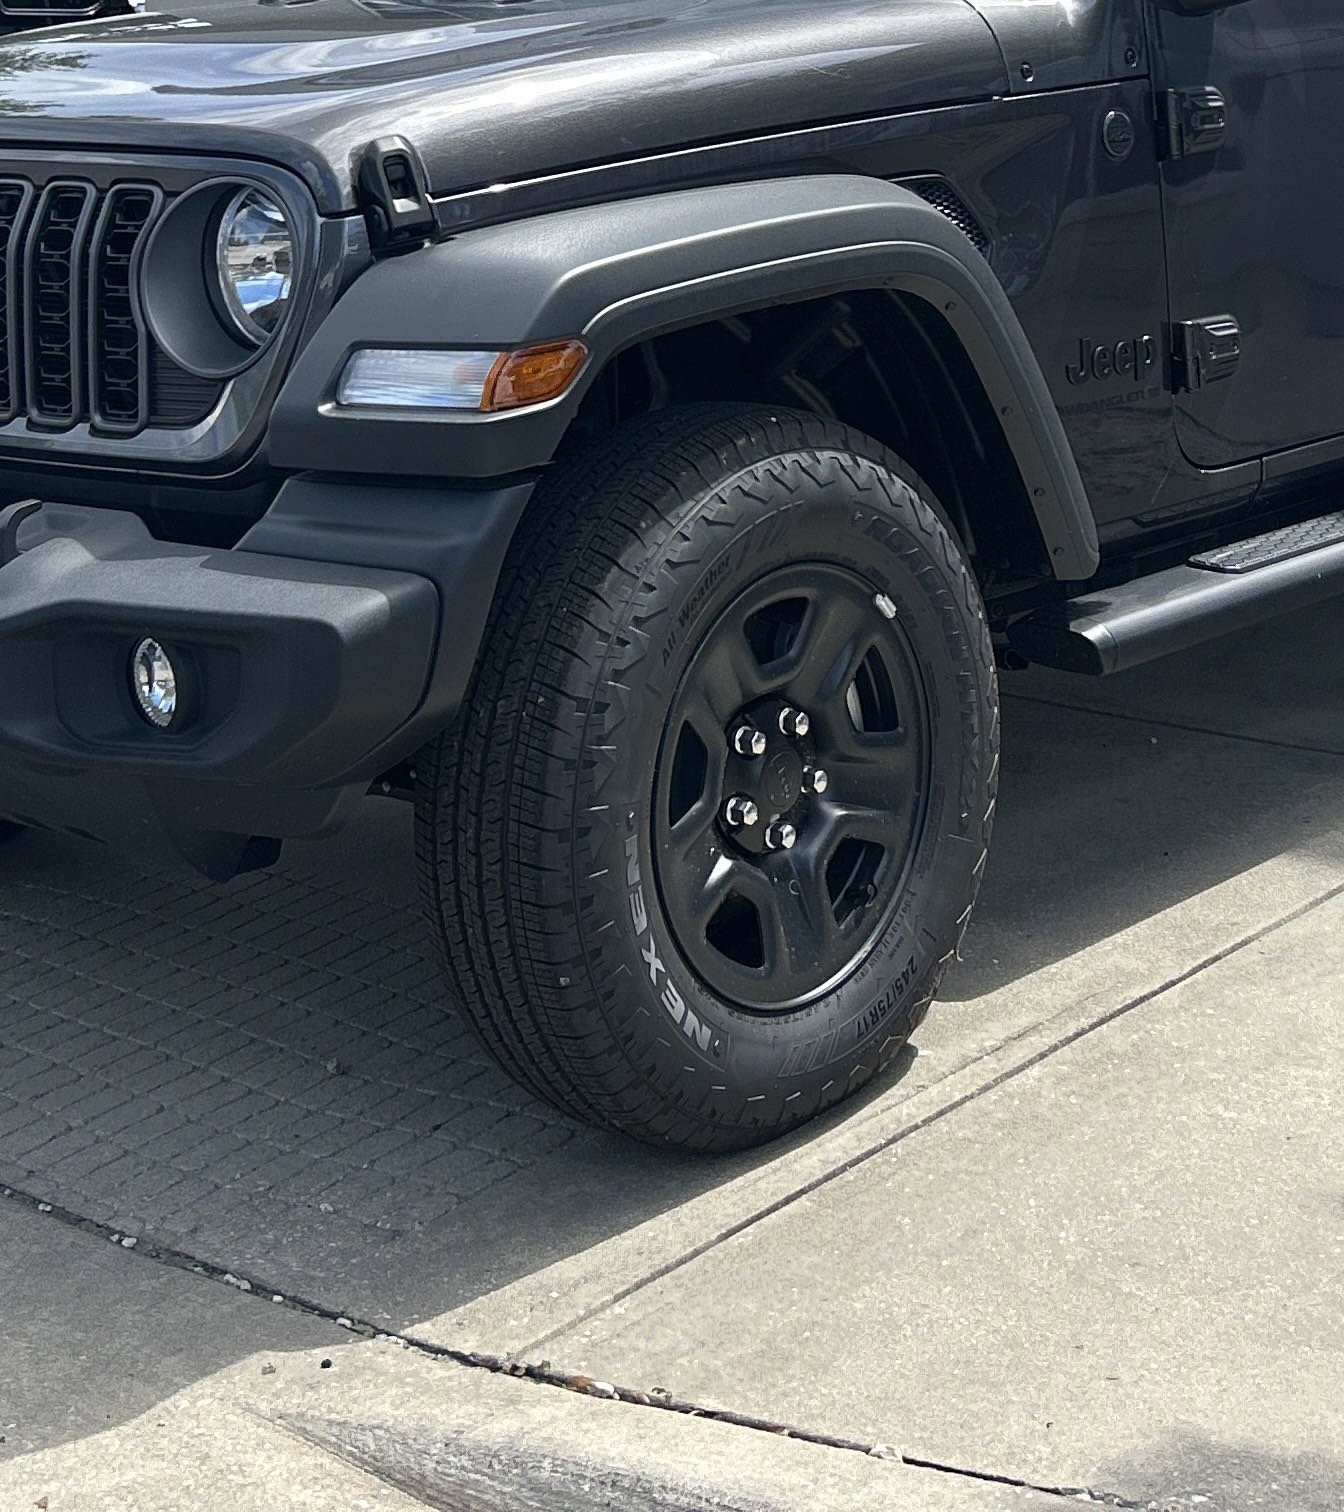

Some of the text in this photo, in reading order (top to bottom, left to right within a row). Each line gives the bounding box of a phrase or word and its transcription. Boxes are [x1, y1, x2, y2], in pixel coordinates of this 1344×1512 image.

[1064, 335, 1154, 386] Jeep
[677, 553, 733, 629] Weather
[623, 833, 713, 1053] NEXEN
[855, 954, 919, 1040] 245/75R17
